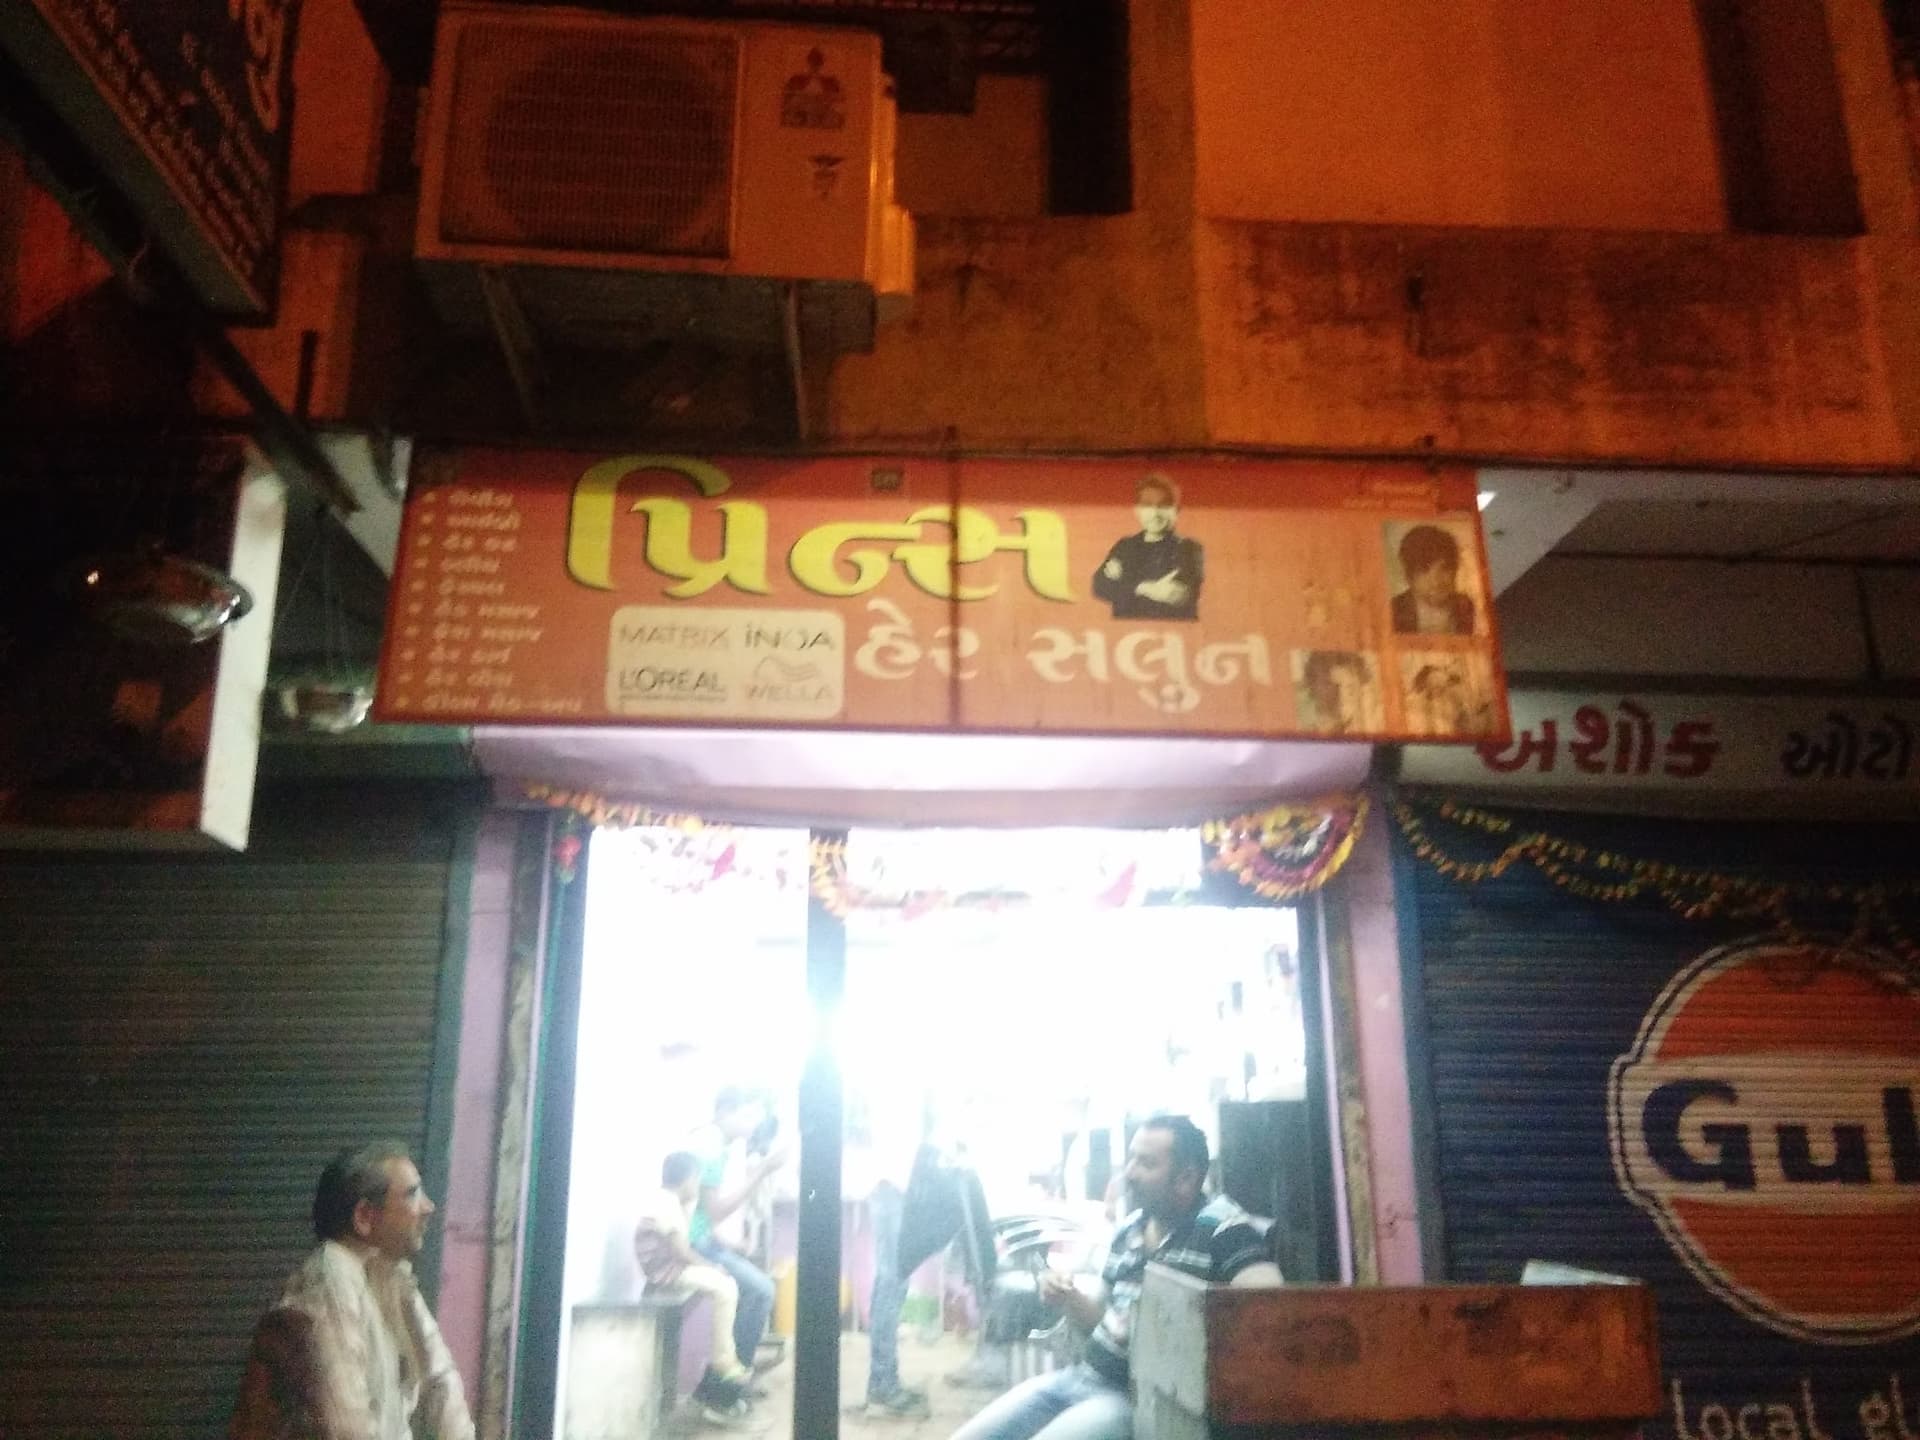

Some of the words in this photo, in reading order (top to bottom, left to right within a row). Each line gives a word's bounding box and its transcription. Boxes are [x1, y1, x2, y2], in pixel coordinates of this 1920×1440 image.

[567, 454, 1075, 603] પ્રિન્સ
[619, 624, 730, 649] MATRIX
[853, 598, 981, 681] હેર
[1026, 627, 1274, 713] સલુન
[1474, 699, 1721, 779] અશોક
